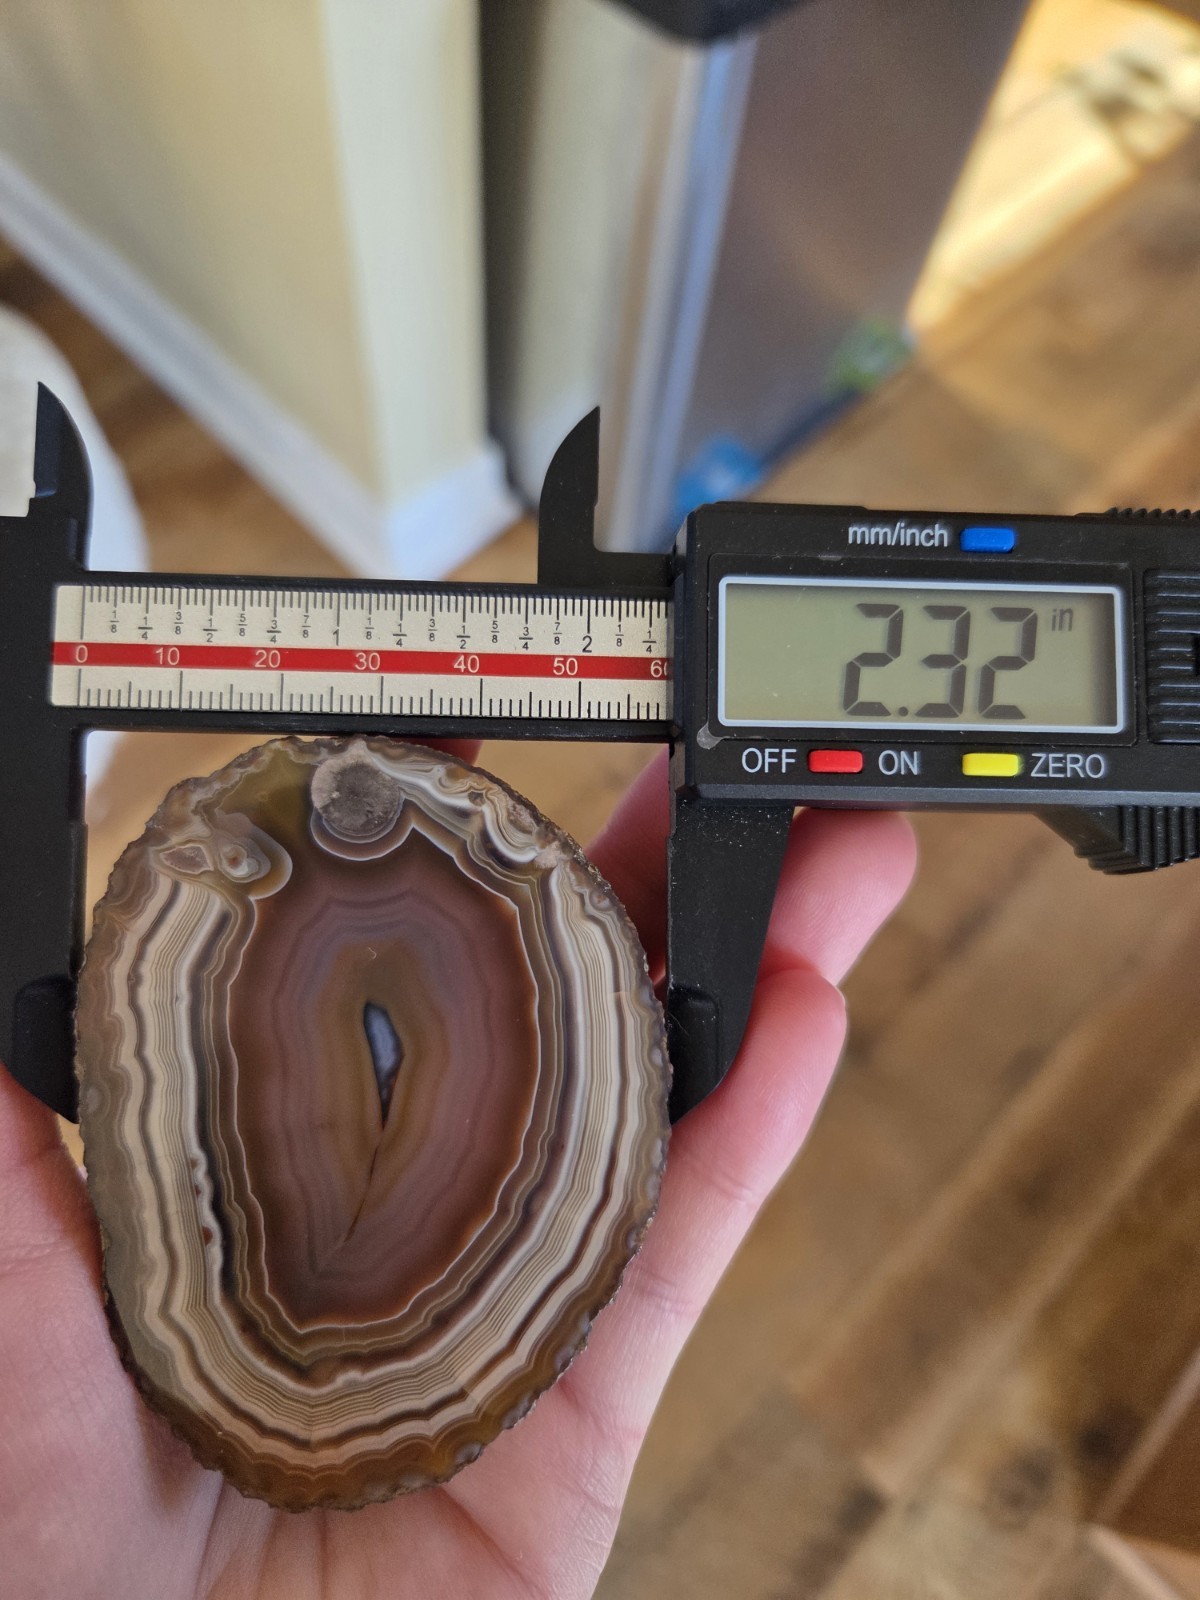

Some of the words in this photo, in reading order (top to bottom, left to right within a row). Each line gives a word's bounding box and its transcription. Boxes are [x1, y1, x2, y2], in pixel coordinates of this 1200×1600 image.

[848, 523, 948, 547] mm/inch
[333, 629, 339, 646] 1
[582, 636, 592, 653] 2
[76, 645, 88, 663] 0
[156, 647, 180, 665] 10
[255, 650, 280, 668] 20
[355, 652, 380, 670] 30
[454, 655, 480, 673] 40
[553, 658, 578, 675] 50
[843, 603, 1038, 720] 2.32
[1051, 607, 1074, 631] in
[741, 748, 797, 773] OFF
[878, 751, 920, 776] ON
[1030, 753, 1105, 779] ZERO
